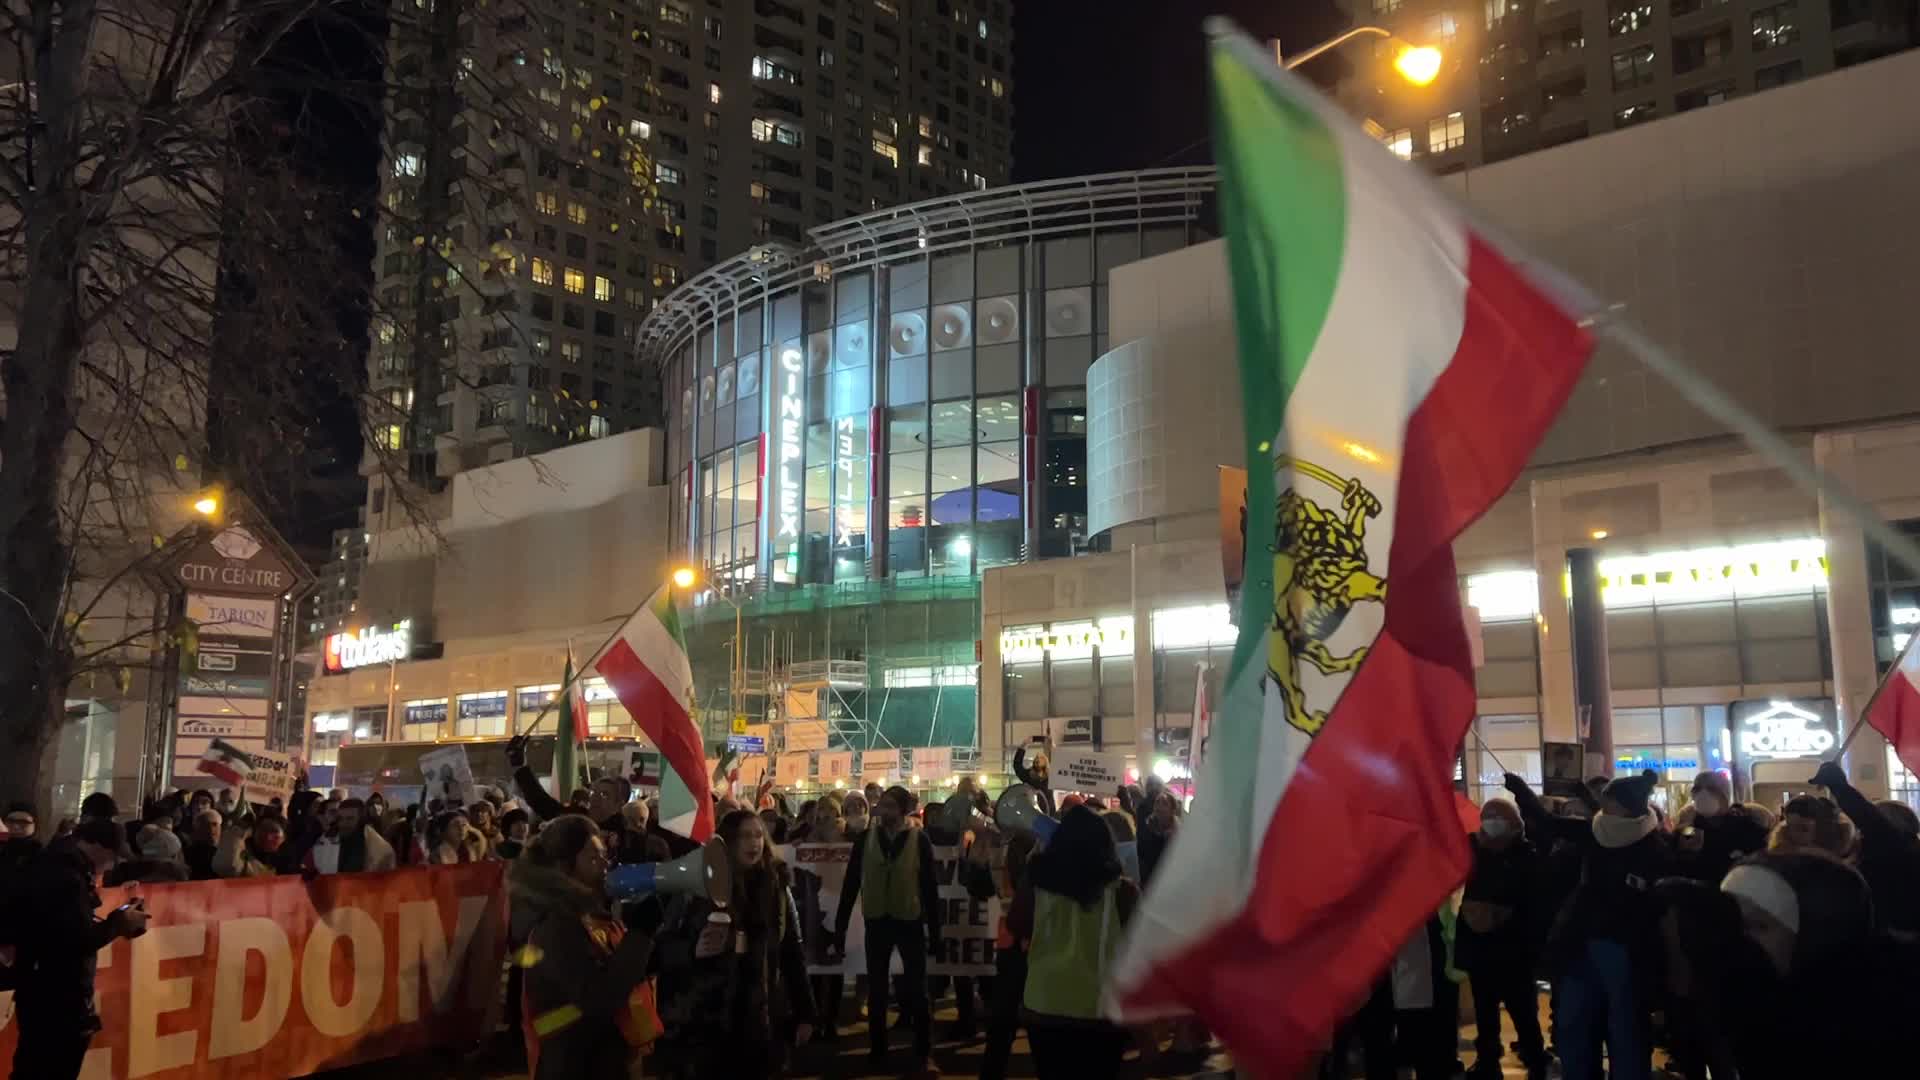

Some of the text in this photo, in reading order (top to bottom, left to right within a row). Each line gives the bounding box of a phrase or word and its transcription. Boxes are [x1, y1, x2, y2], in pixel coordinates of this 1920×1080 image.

[780, 349, 803, 538] CINEPLEX
[181, 563, 282, 587] CITY CENTRE
[208, 606, 266, 622] TARION
[935, 898, 989, 926] IFE
[78, 896, 489, 1080] EDOM
